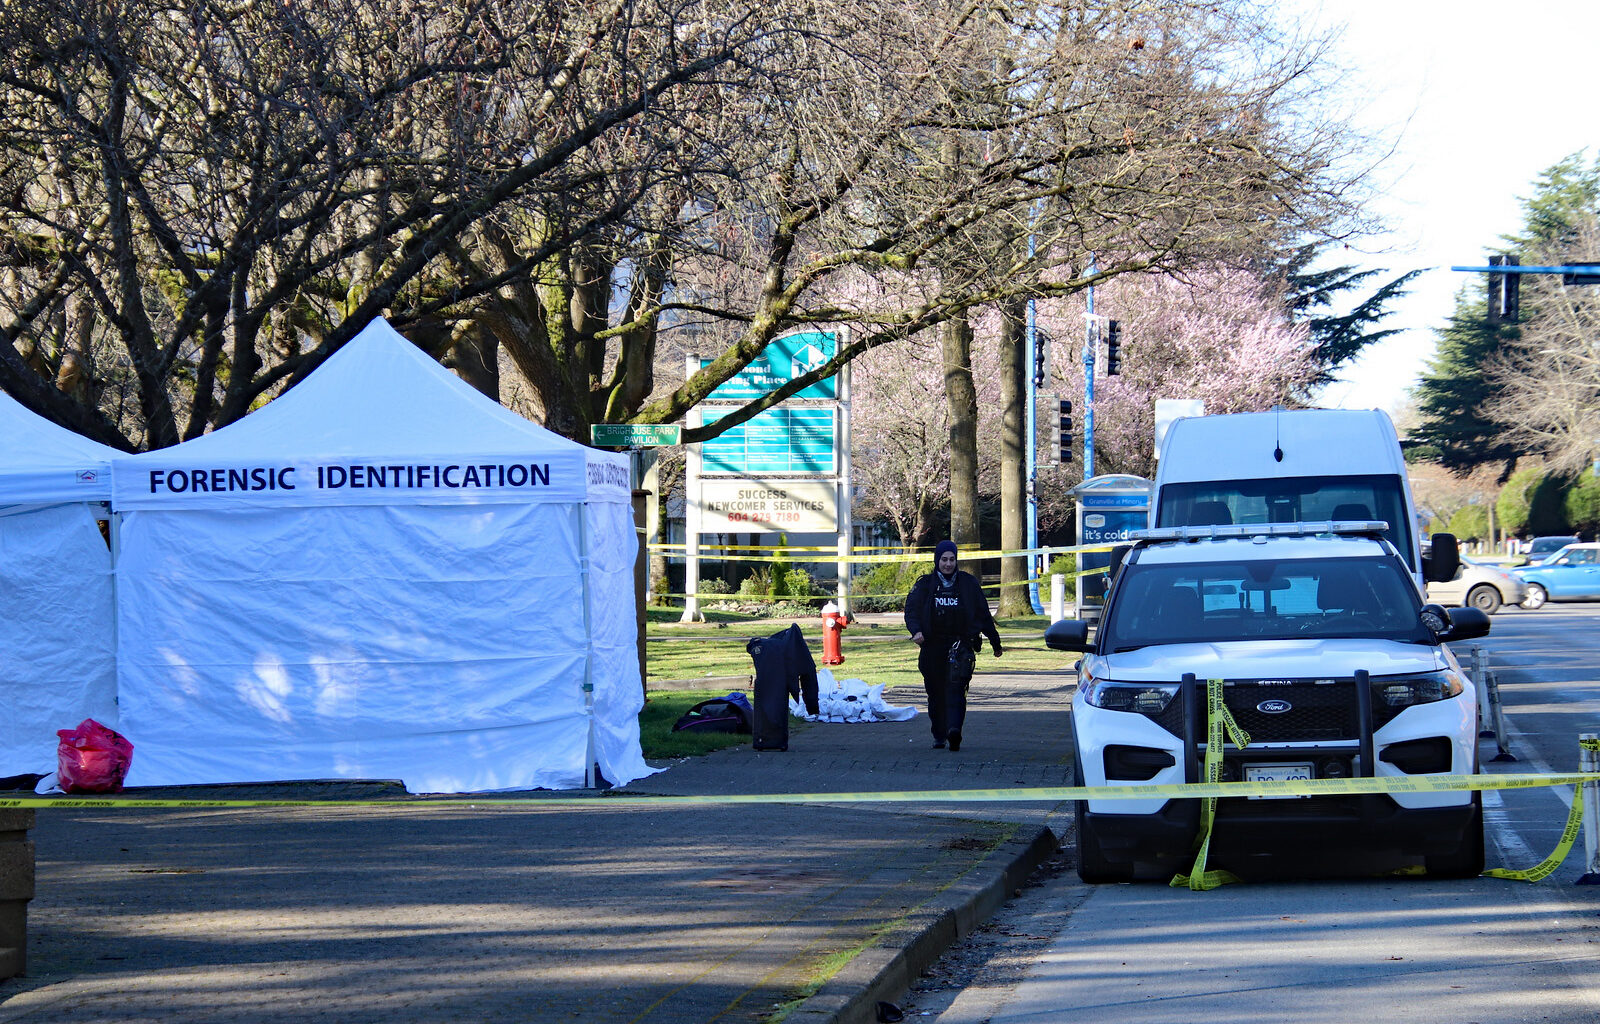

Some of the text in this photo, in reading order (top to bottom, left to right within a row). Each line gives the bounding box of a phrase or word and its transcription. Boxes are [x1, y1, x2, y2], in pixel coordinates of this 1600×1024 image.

[753, 375, 787, 384] Place
[607, 427, 676, 435] BRIGHOUSE PARK
[624, 436, 659, 444] PAVILION
[150, 463, 550, 494] FORENSIC IDENTIFICATION
[738, 490, 787, 500] SUCCESS
[708, 501, 825, 511] NEWCOMER SERVICES
[728, 512, 749, 522] 604
[776, 512, 800, 522] 7180
[1085, 530, 1102, 540] it's
[935, 597, 958, 607] POLICE
[1264, 702, 1284, 711] Ford
